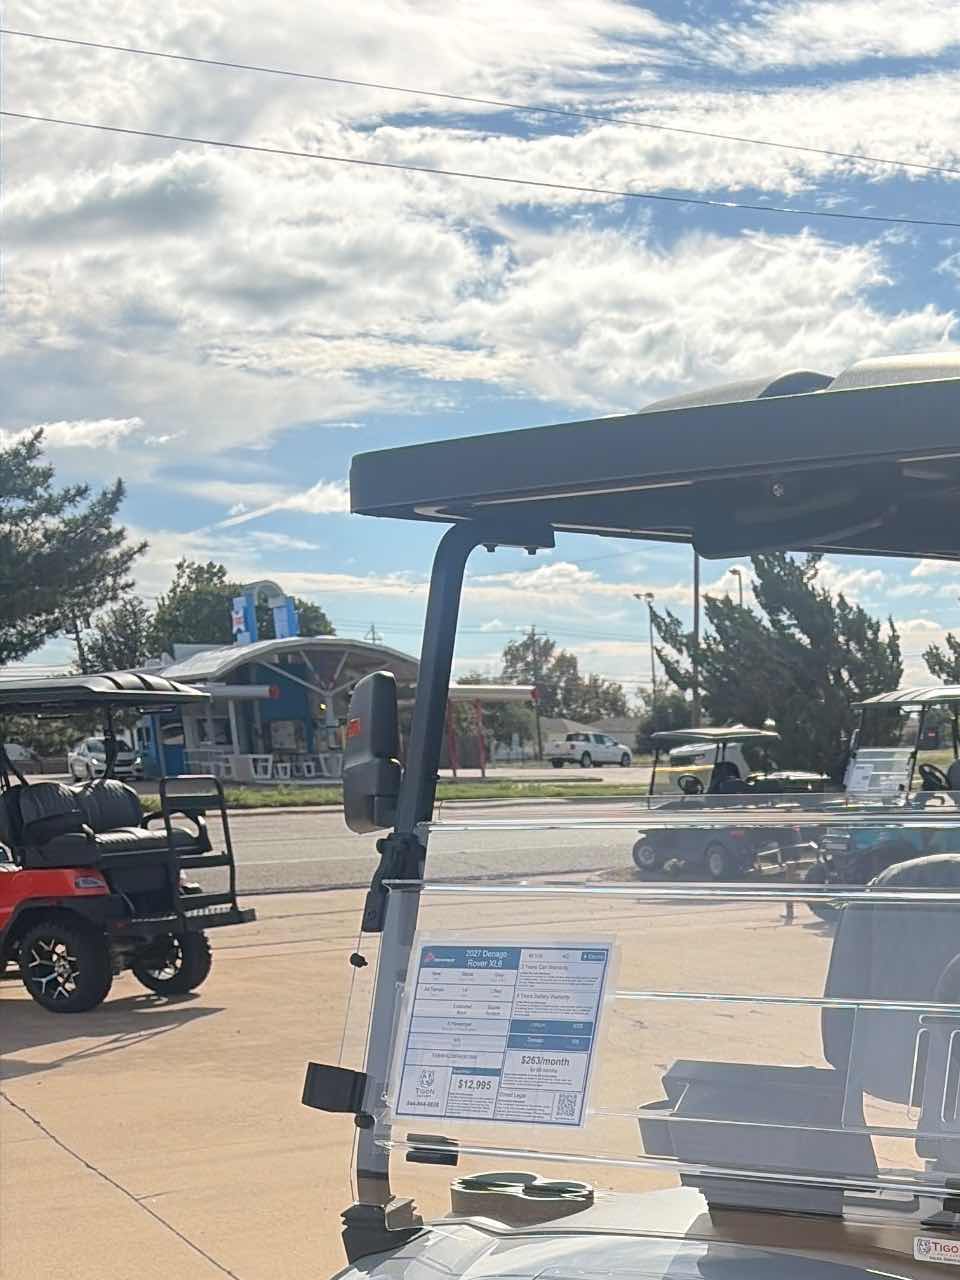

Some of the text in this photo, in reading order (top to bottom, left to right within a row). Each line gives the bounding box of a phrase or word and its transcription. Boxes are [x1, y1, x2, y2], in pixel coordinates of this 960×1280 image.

[482, 950, 508, 959] Denago
[467, 959, 487, 968] Rover
[458, 1079, 492, 1090] $12,995
